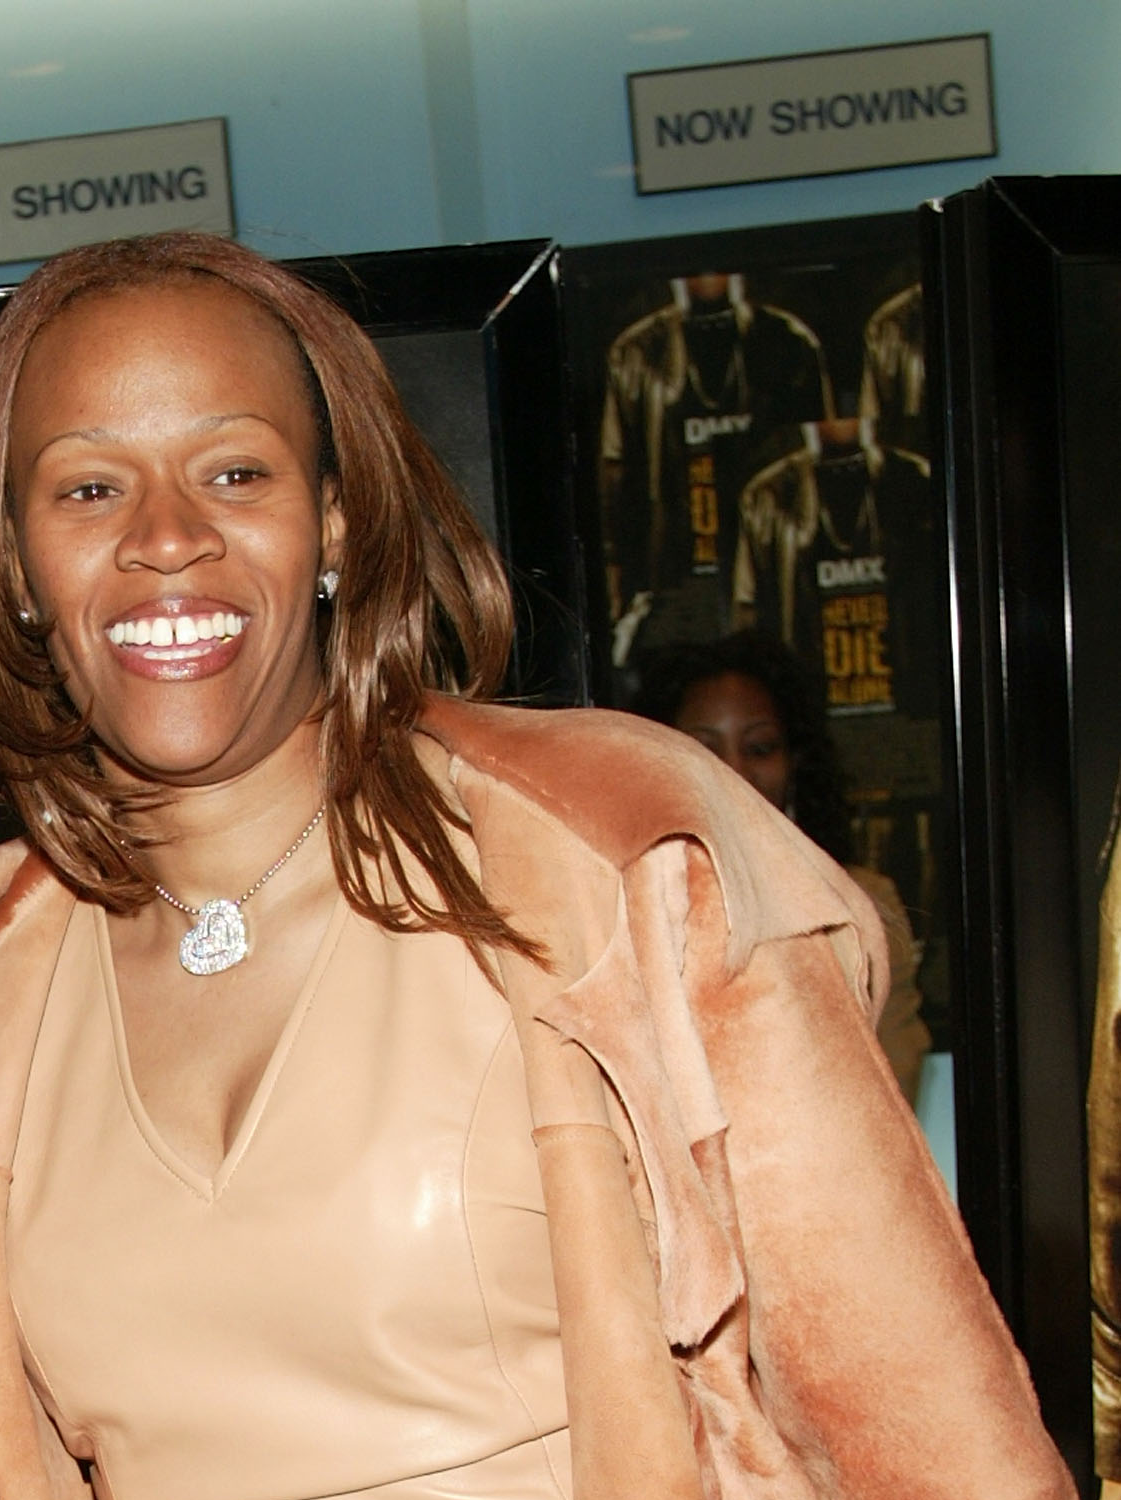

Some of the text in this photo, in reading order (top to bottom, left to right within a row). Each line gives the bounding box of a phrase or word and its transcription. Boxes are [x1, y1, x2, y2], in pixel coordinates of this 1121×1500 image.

[655, 82, 967, 147] NOW SHOWING
[12, 166, 208, 220] SHOWING
[817, 556, 886, 588] DMX
[825, 629, 892, 676] DIE
